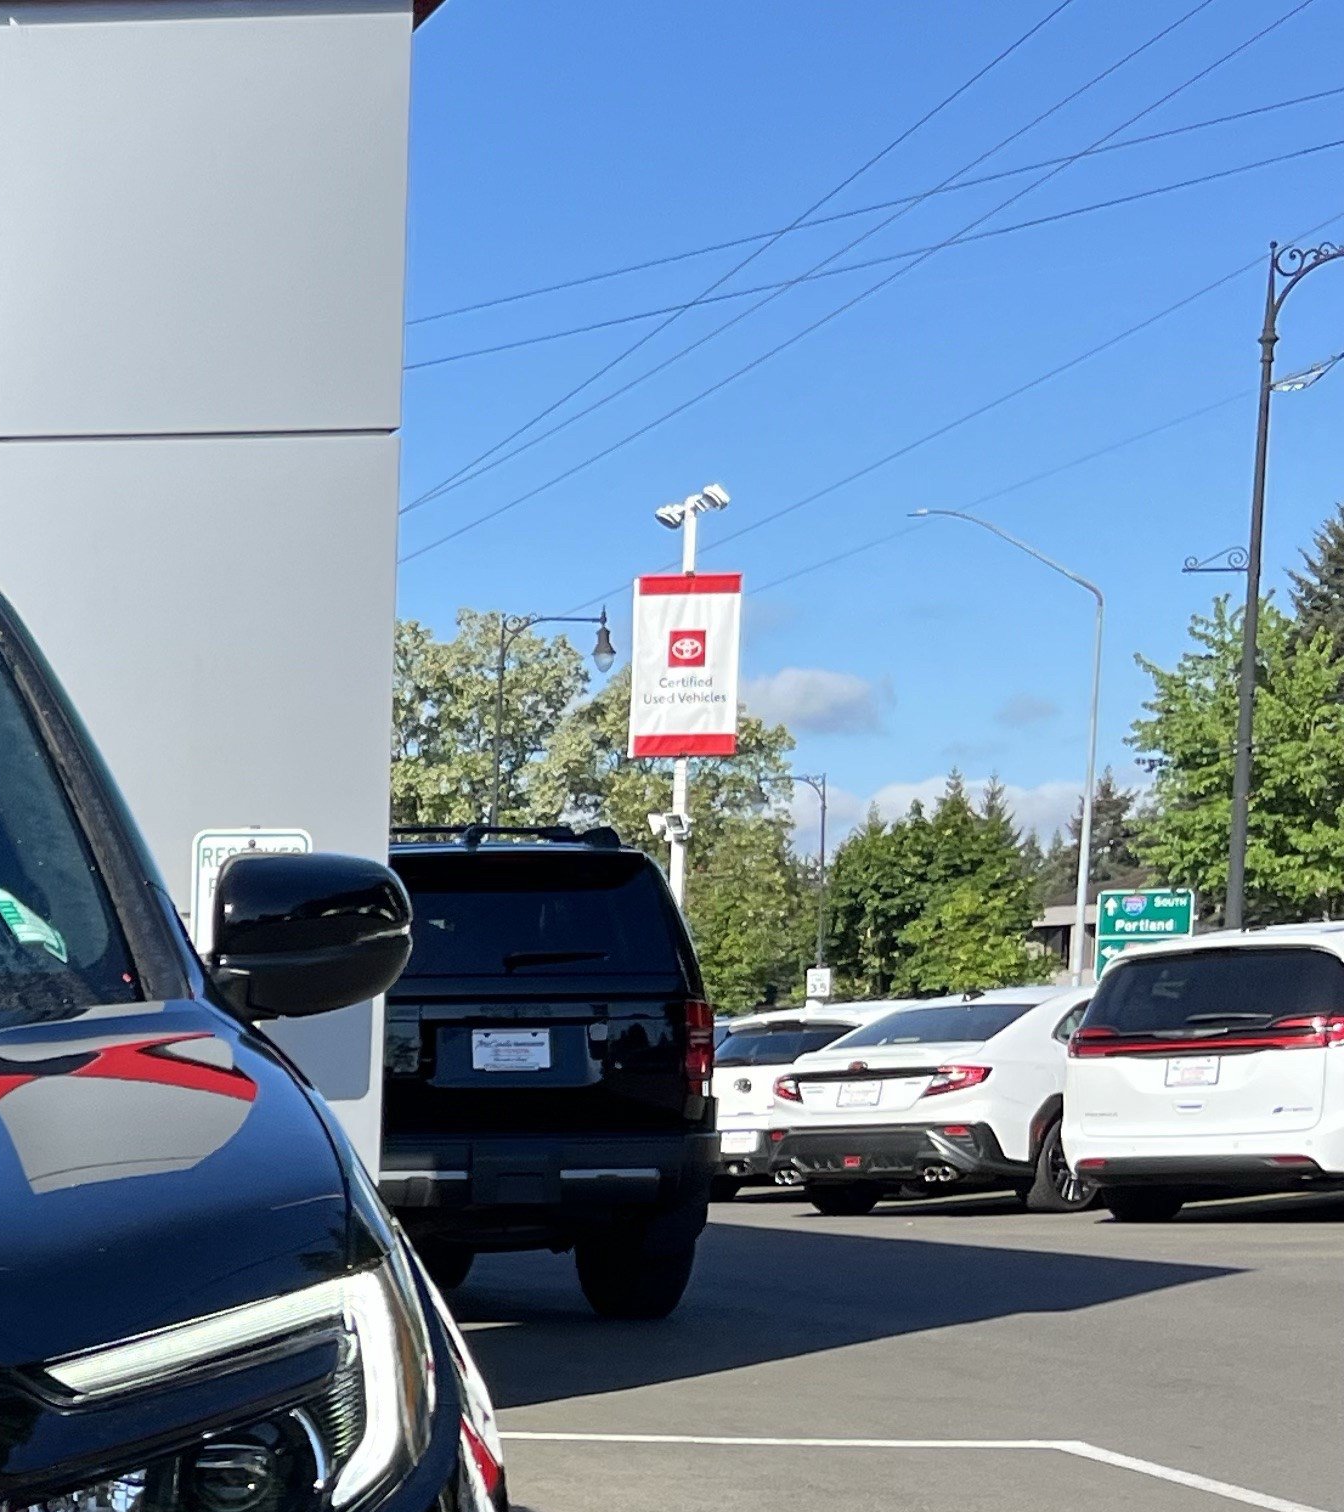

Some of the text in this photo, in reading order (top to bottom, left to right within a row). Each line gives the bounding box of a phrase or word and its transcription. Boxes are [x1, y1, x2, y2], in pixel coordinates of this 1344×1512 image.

[659, 676, 713, 689] Certified
[643, 692, 727, 705] Used Vehicles
[1114, 919, 1175, 932] Portland
